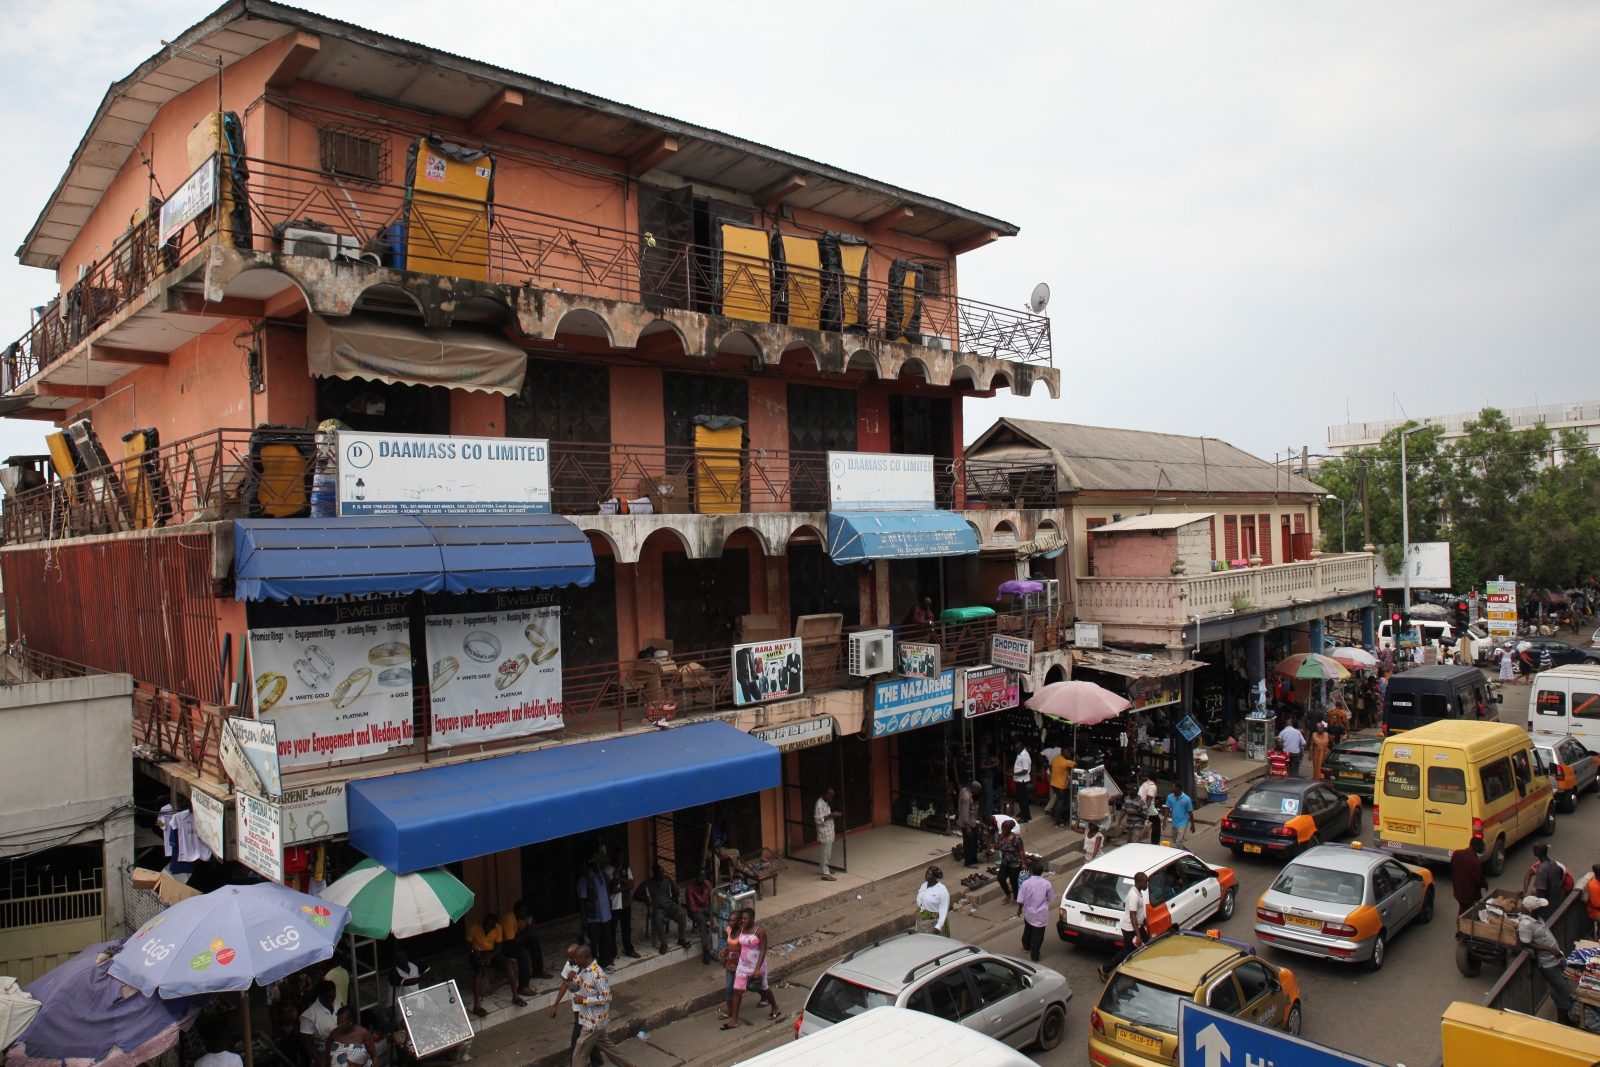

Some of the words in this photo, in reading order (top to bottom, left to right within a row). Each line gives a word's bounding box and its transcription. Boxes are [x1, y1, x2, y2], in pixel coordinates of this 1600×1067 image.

[353, 446, 362, 458] D
[379, 440, 456, 460] DAAMASS
[461, 443, 482, 460] CO
[488, 444, 545, 462] LIMITED
[848, 458, 888, 471] DAAMASS
[890, 460, 900, 472] CO
[903, 460, 932, 472] LIMITED
[496, 592, 554, 610] JEWELLERY
[335, 602, 408, 622] JEWELLERY
[427, 618, 442, 627] Promise
[442, 618, 453, 627] Rings
[464, 616, 487, 627] Engagement
[487, 615, 497, 626] Rings
[252, 632, 270, 642] Promise
[270, 631, 284, 643] Rings
[295, 629, 324, 642] Engagement
[324, 628, 336, 640] Rings
[347, 626, 365, 638] Wedding
[365, 624, 377, 636] Rings
[387, 622, 402, 632] Eternity
[766, 650, 782, 658] SUITS
[995, 638, 1028, 653] SHOPRITE
[878, 684, 898, 704] THE
[901, 674, 952, 700] NAZARENE
[904, 690, 949, 704] JEWELLERY
[342, 711, 369, 720] PLATINUM
[435, 714, 459, 736] Engrave
[460, 714, 474, 733] your
[475, 706, 511, 730] Engagement
[512, 702, 523, 722] and
[523, 699, 546, 721] Wedding
[547, 696, 562, 718] Rings
[232, 721, 257, 744] Citizen
[260, 728, 276, 746] Gold
[294, 736, 310, 758] your
[312, 728, 355, 756] Engagement
[356, 723, 370, 746] and
[371, 720, 401, 744] Wedding
[259, 926, 300, 952] tigo
[1207, 930, 1218, 938] TAXI
[142, 937, 176, 966] tigo
